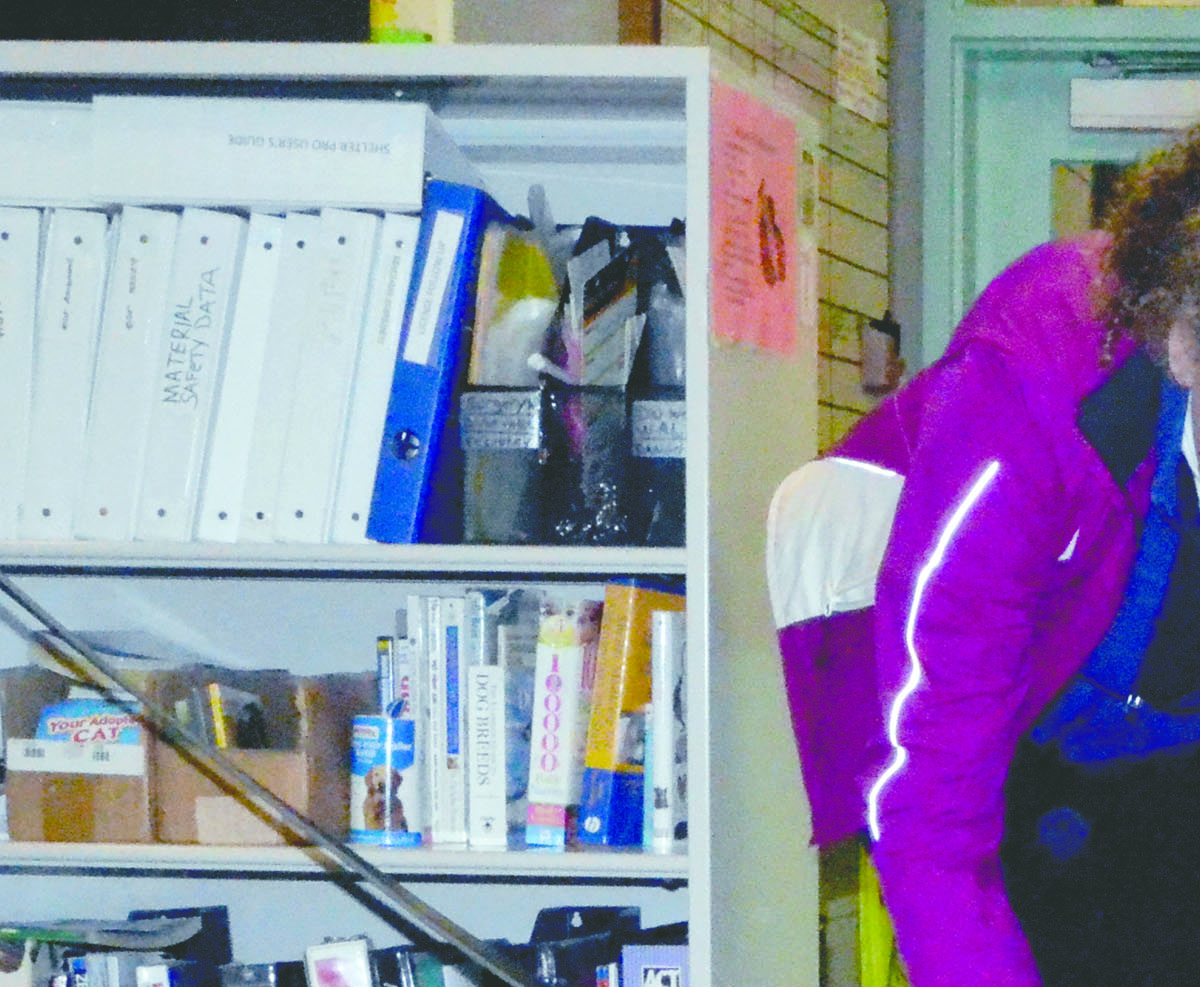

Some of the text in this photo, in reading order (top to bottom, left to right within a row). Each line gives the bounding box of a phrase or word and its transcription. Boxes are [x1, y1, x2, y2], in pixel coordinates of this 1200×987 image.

[227, 133, 265, 148] GUIDE
[312, 139, 336, 152] PRO
[340, 142, 391, 155] SHELTER
[194, 266, 221, 329] DATA
[161, 297, 193, 403] MATERIAL
[50, 718, 87, 732] Your
[475, 673, 491, 786] DOG BREEDS
[73, 727, 119, 744] CAT
